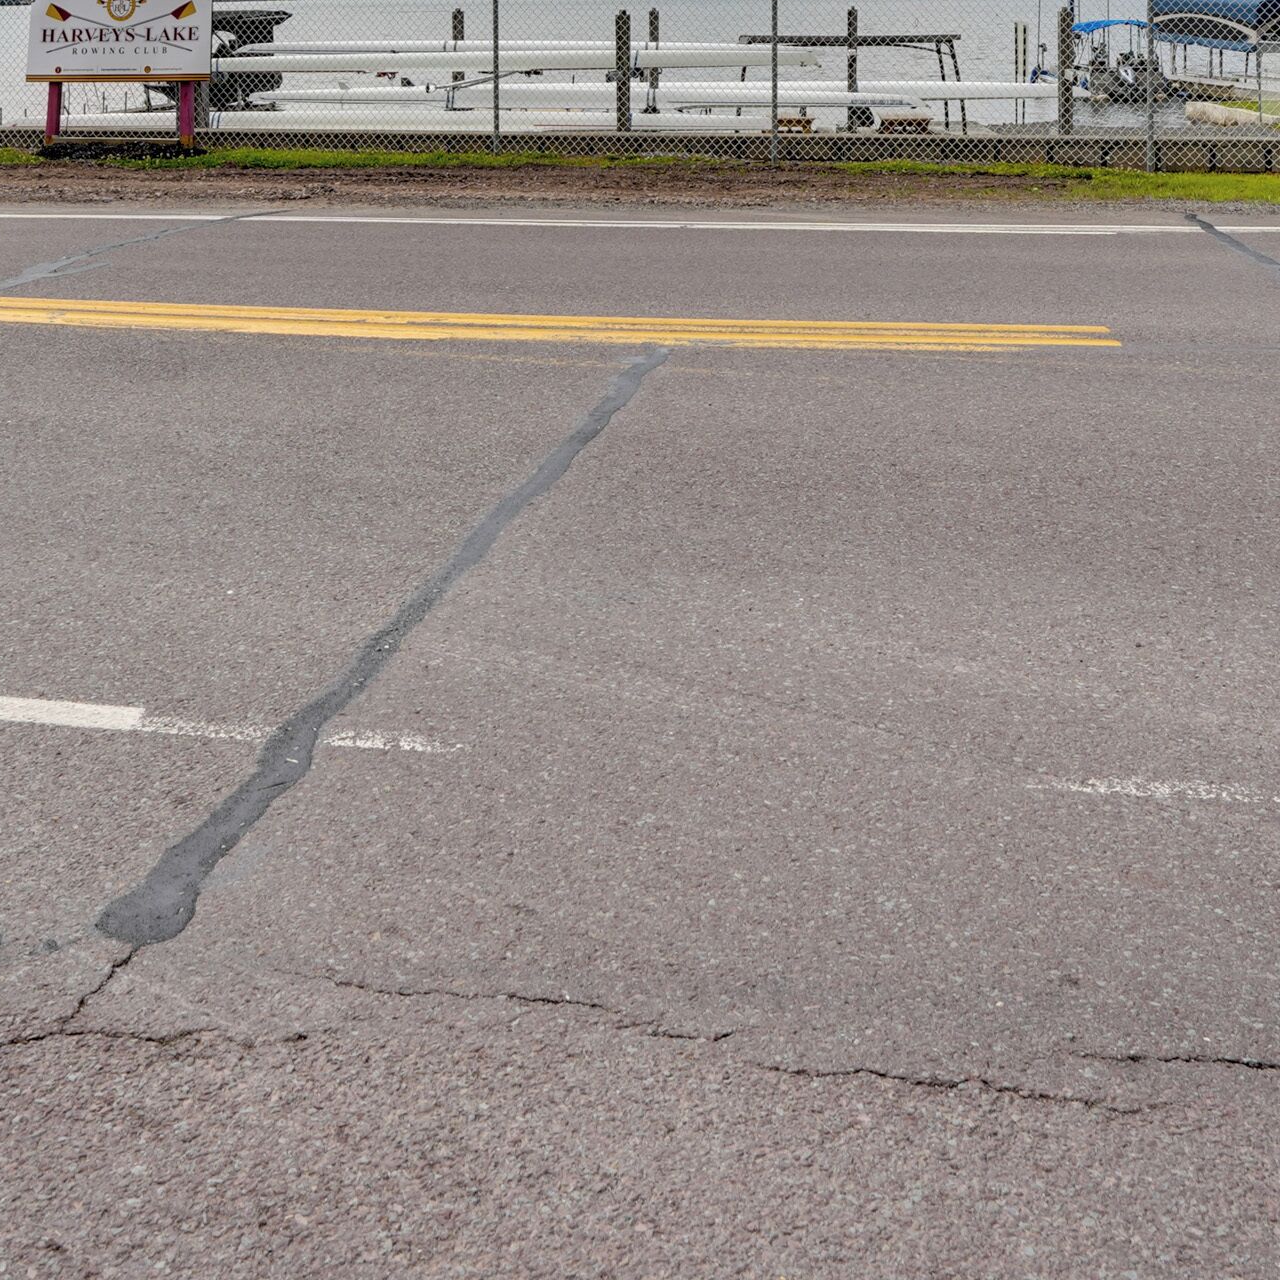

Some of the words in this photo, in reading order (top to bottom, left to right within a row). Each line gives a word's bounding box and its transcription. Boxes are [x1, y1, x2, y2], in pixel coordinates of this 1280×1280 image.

[145, 26, 200, 42] LAKE
[72, 46, 126, 55] ROWING
[134, 46, 168, 55] CLUB
